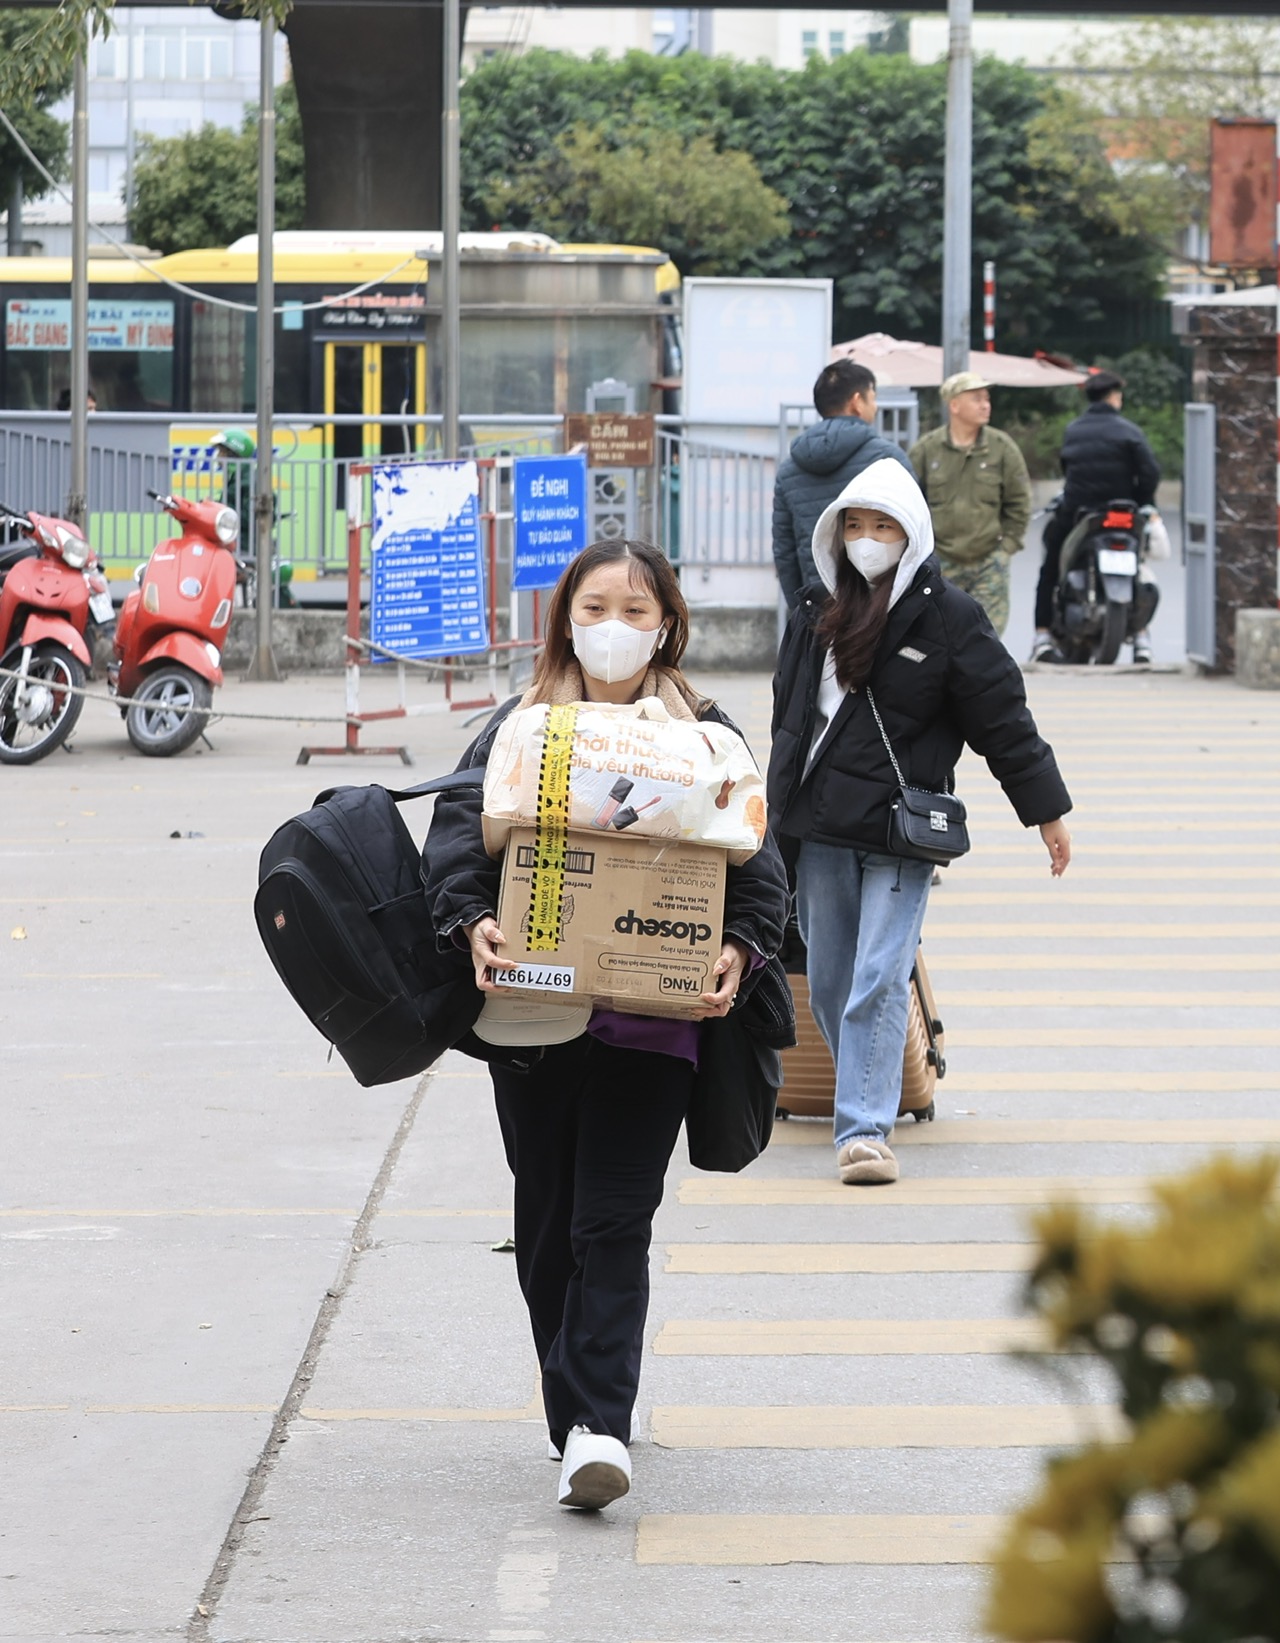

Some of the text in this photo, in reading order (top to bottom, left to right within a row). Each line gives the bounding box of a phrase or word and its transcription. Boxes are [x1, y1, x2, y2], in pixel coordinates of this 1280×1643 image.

[575, 733, 610, 752] hời
[596, 757, 628, 774] yêu
[512, 876, 530, 884] Burst
[690, 905, 708, 913] Thơm
[614, 909, 712, 946] closeup
[661, 944, 676, 953] răng
[676, 946, 694, 956] đánh
[639, 961, 657, 969] Closeup
[498, 969, 572, 987] 69771997
[663, 976, 699, 993] TẶNG
